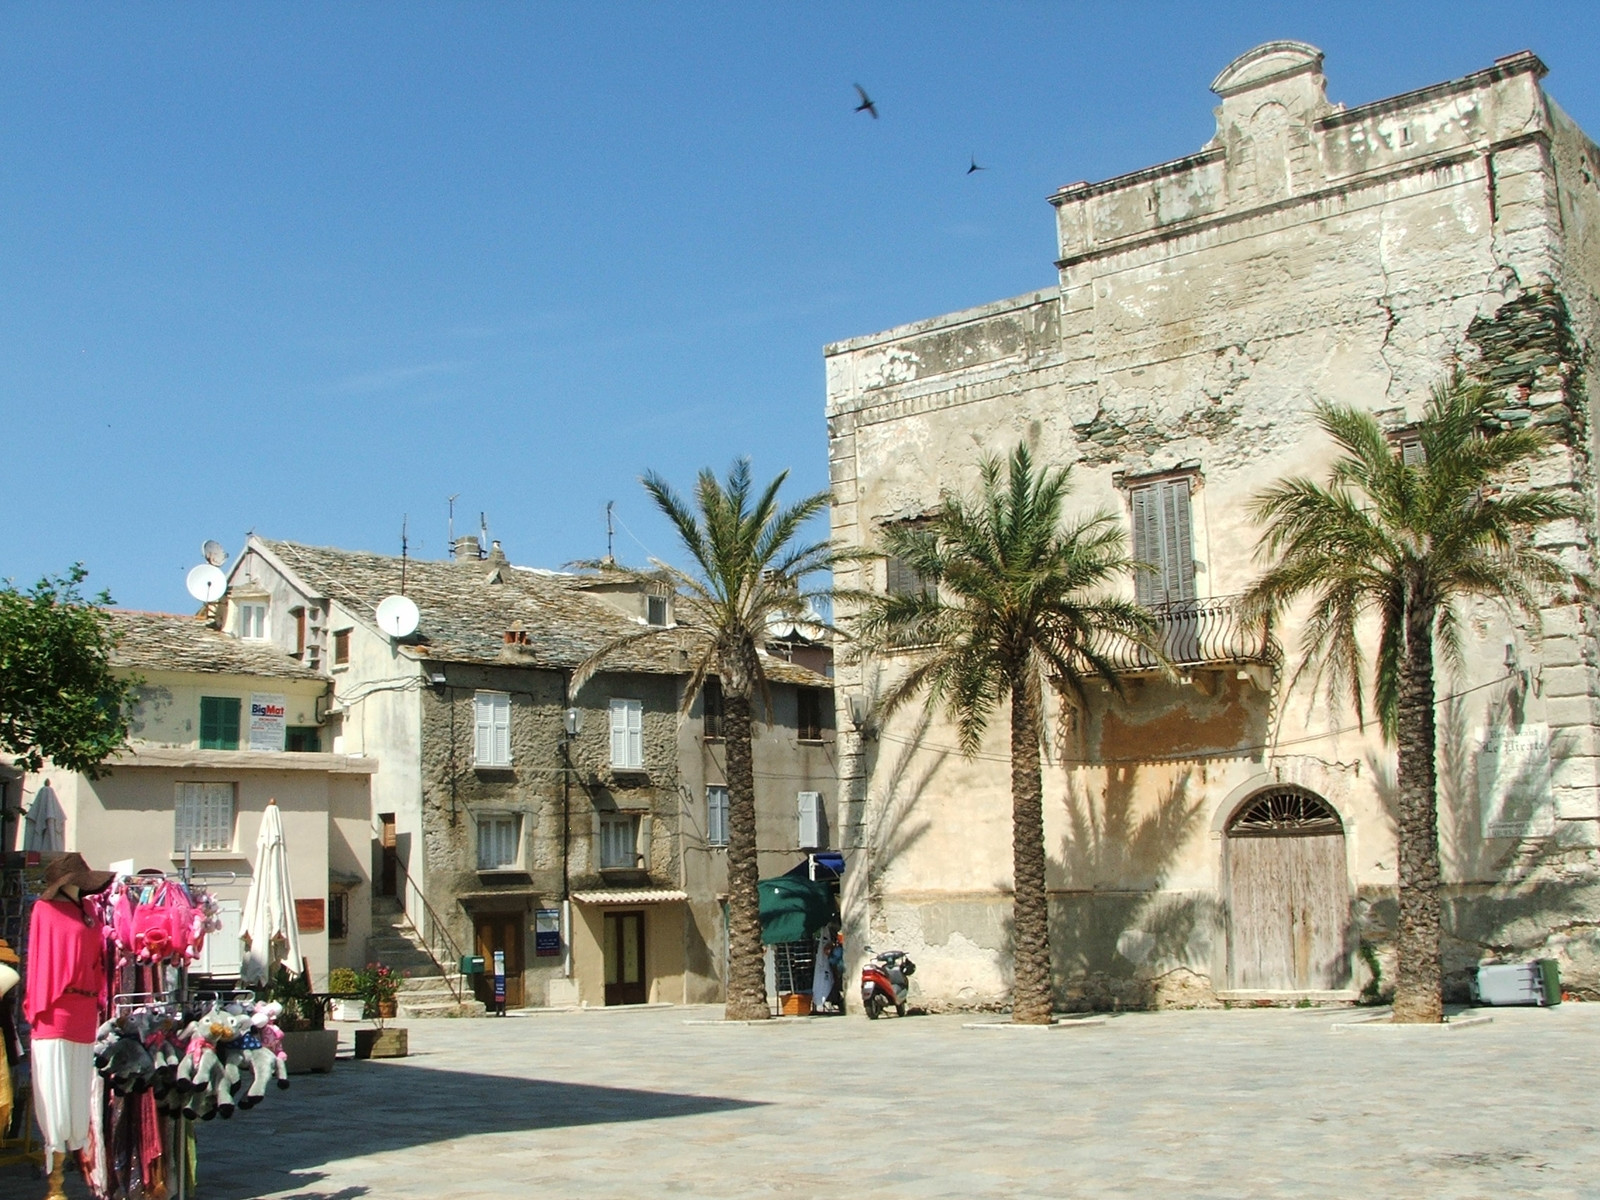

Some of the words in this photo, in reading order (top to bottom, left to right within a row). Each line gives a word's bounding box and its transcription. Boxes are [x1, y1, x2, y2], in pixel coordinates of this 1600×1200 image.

[252, 704, 284, 716] BigMat
[1483, 741, 1498, 753] Le
[1503, 740, 1545, 754] Pirate
